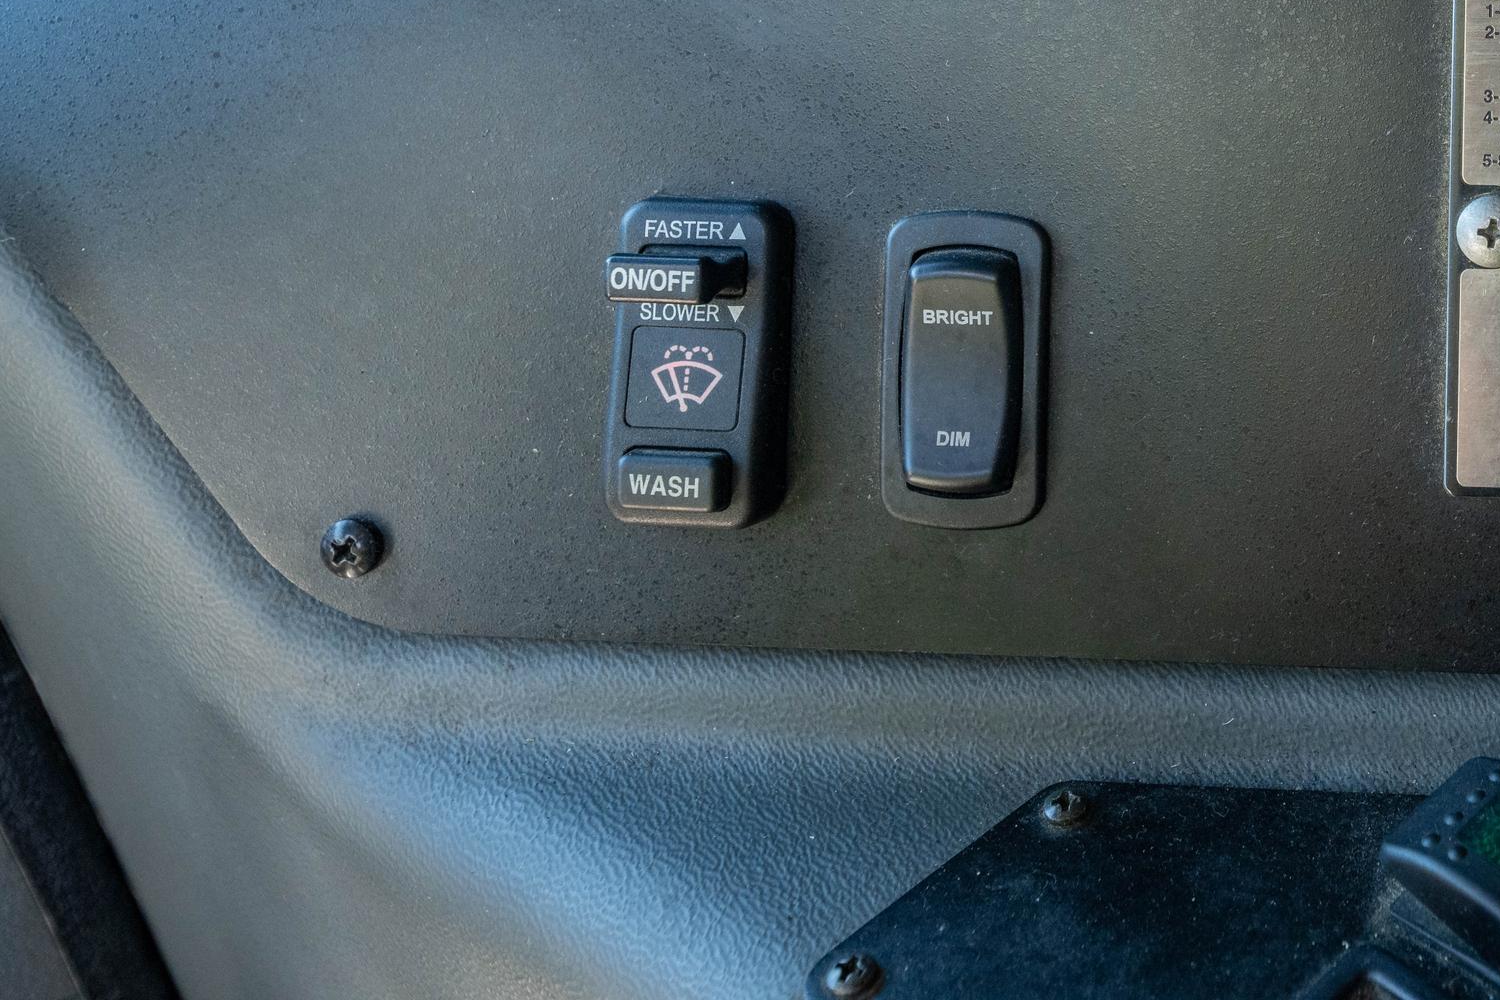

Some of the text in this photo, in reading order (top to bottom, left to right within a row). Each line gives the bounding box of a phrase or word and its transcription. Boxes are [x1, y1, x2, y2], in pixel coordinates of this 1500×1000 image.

[644, 220, 724, 240] FASTER
[610, 267, 695, 293] ON/OFF
[640, 302, 720, 322] SLOWER
[922, 309, 993, 326] BRIGHT
[936, 431, 971, 447] DIM
[629, 473, 700, 498] WASH
